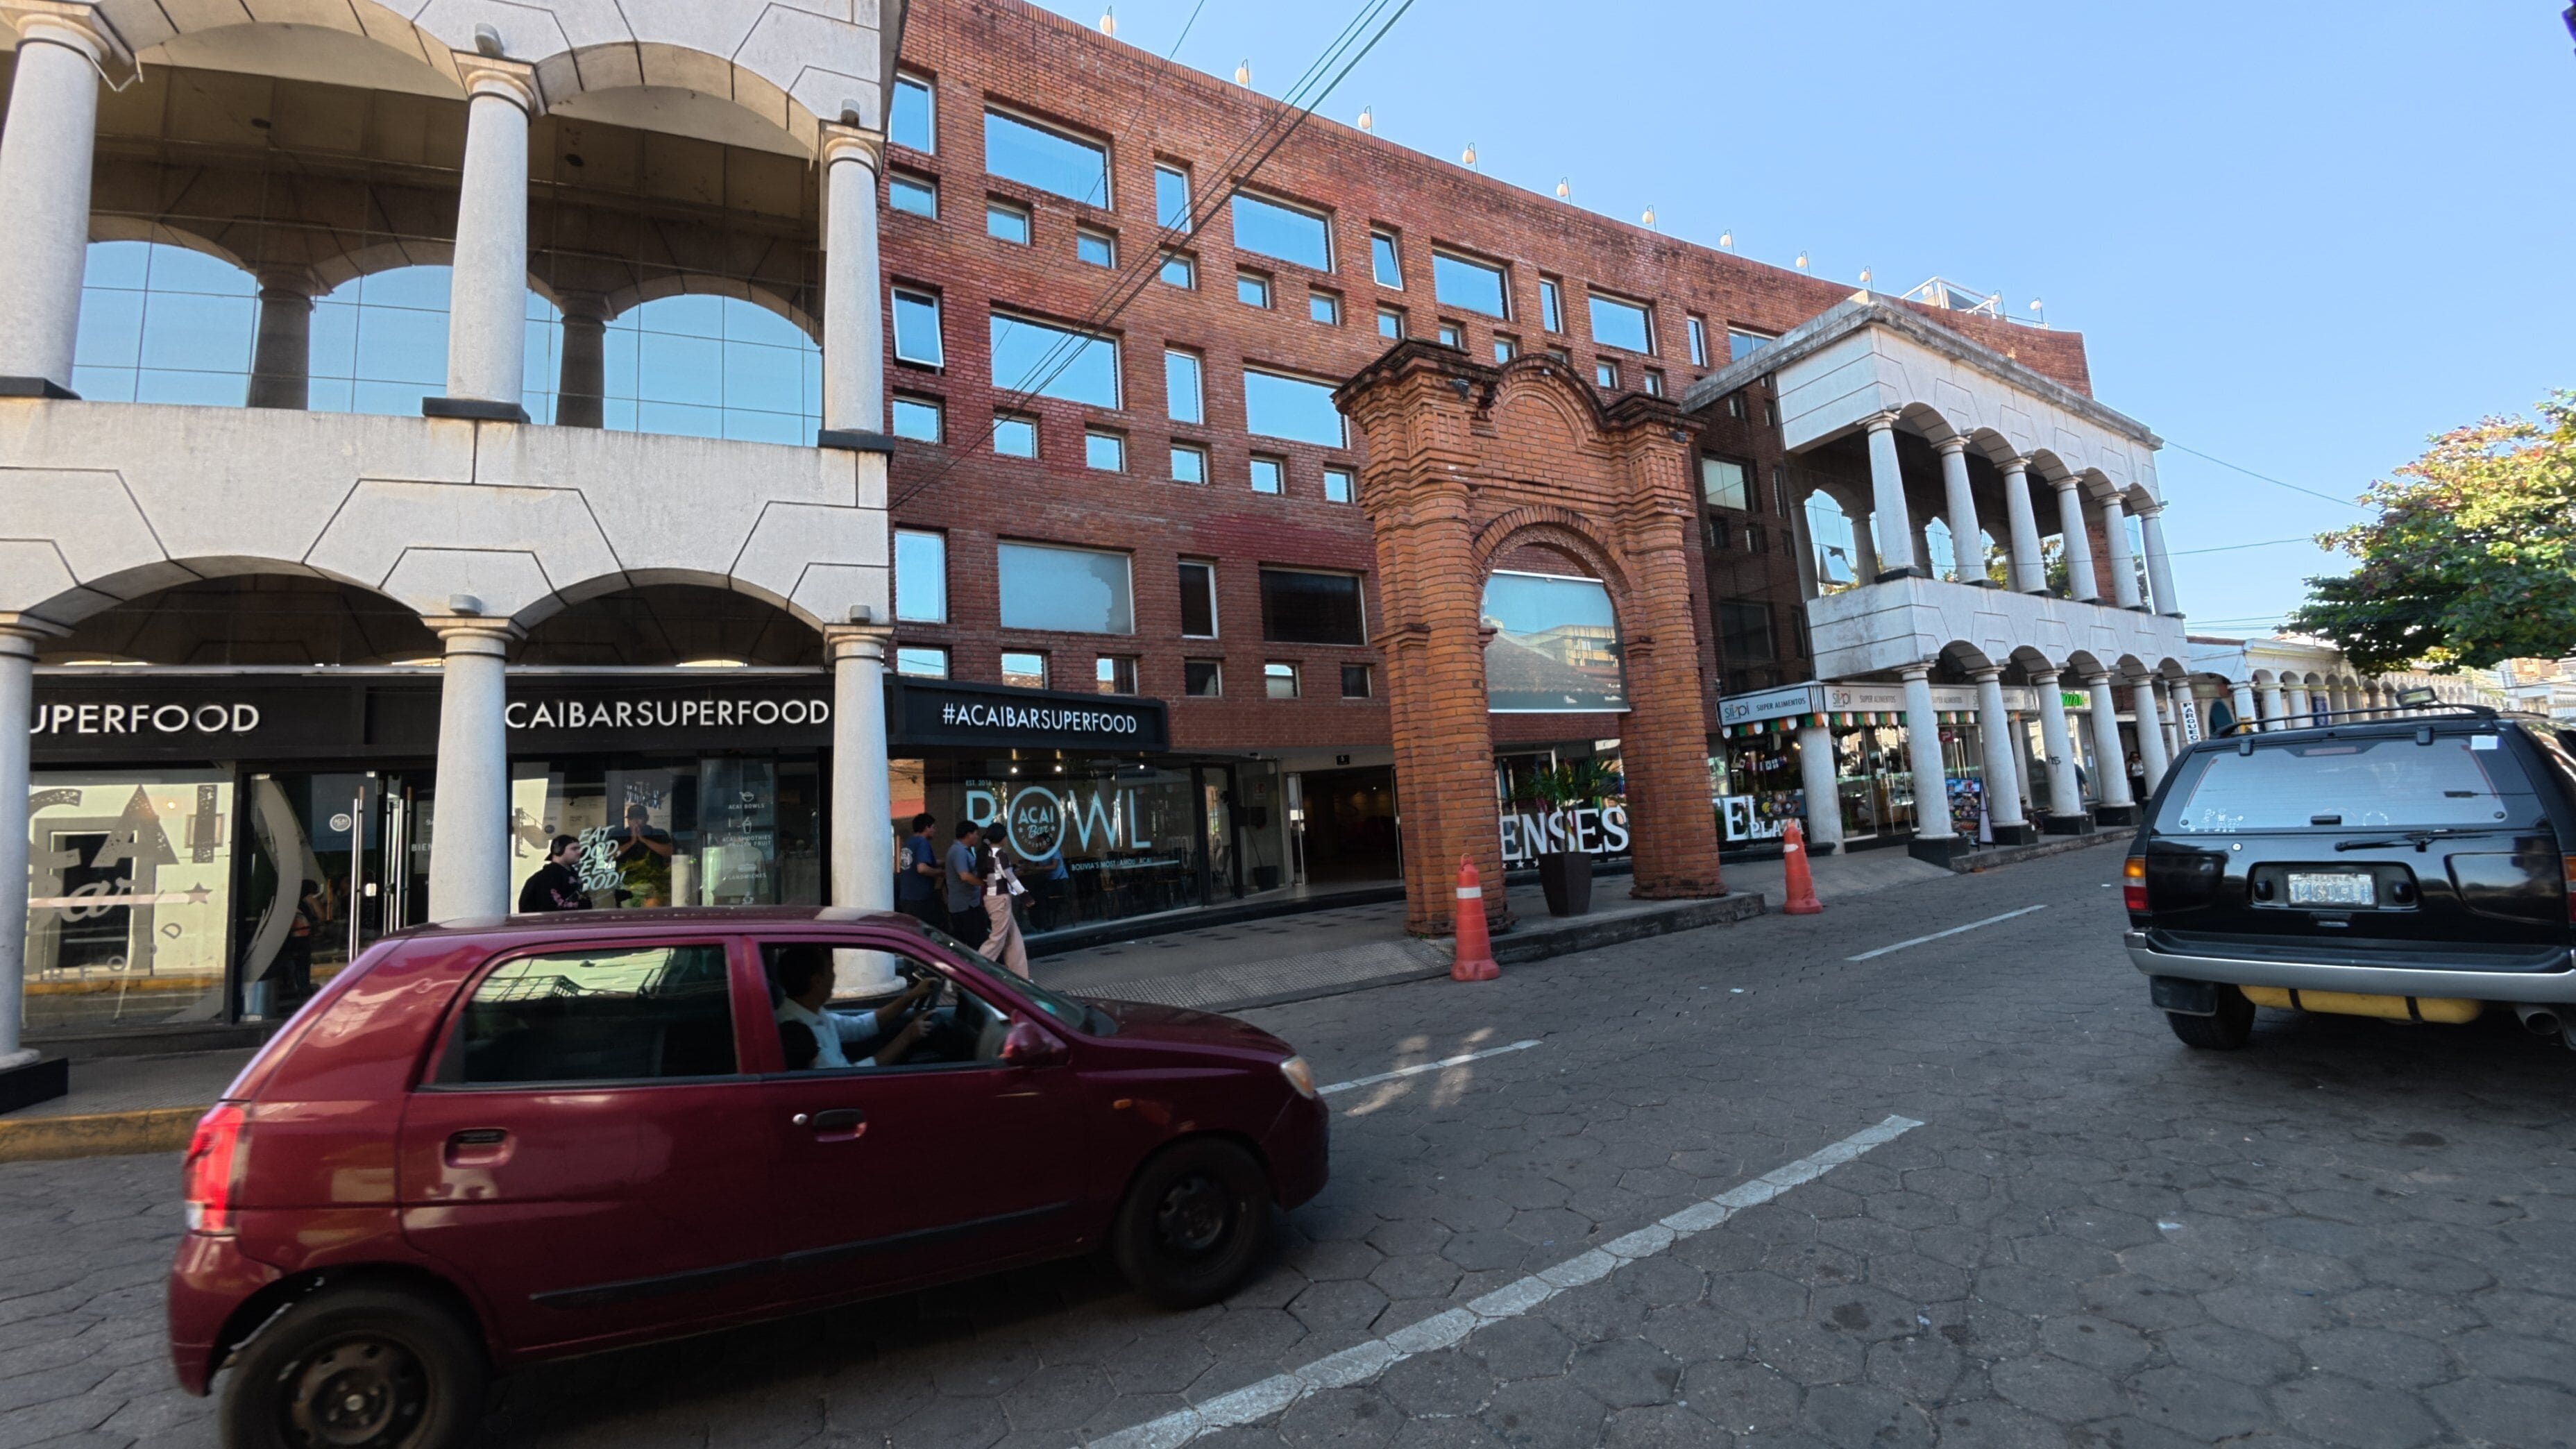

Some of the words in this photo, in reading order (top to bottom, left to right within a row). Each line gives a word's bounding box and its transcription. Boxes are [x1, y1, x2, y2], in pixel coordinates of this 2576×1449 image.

[1756, 703, 1773, 712] SUPER
[1775, 697, 1806, 708] ALIMENTOS
[942, 702, 1137, 734] #ACAIBARSUPERFOOD
[2183, 702, 2198, 740] PARQUEO
[1018, 806, 1054, 824] ACAI
[578, 824, 615, 845] EAT
[1027, 824, 1050, 839] Bar
[1499, 806, 1629, 861] ENSES
